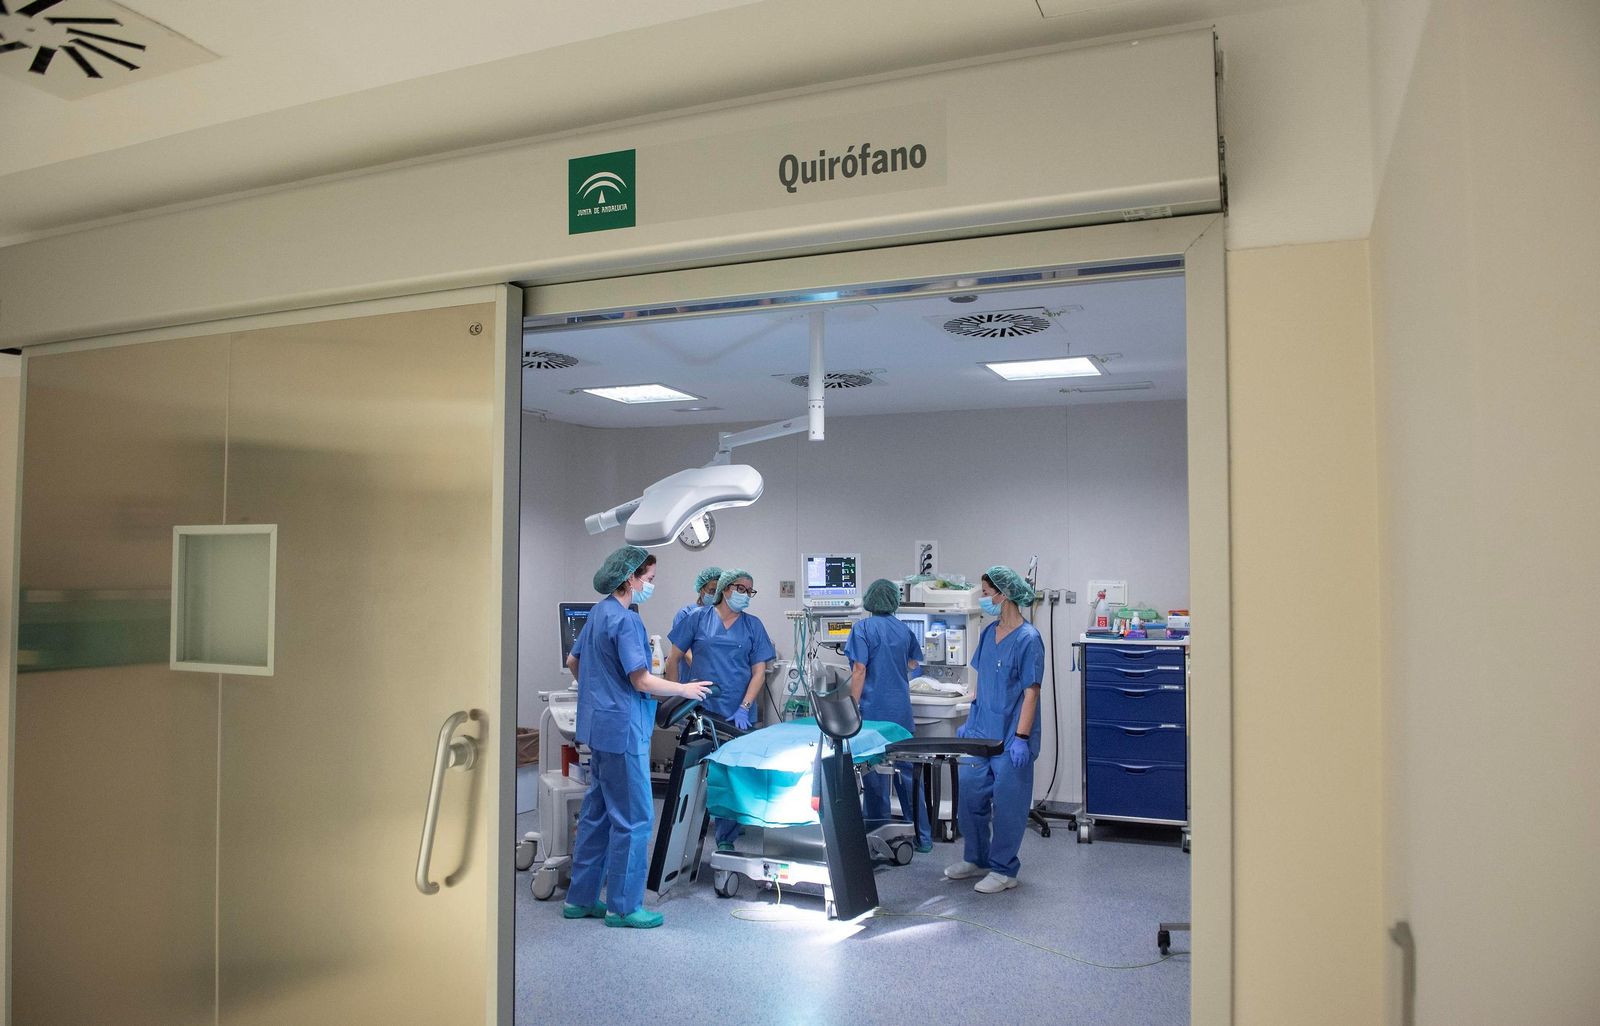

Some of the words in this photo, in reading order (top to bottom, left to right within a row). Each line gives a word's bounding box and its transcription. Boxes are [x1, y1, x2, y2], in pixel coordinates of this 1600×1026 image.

[779, 143, 927, 193] Quirófano
[576, 208, 592, 217] JUNTA
[593, 206, 600, 215] DE
